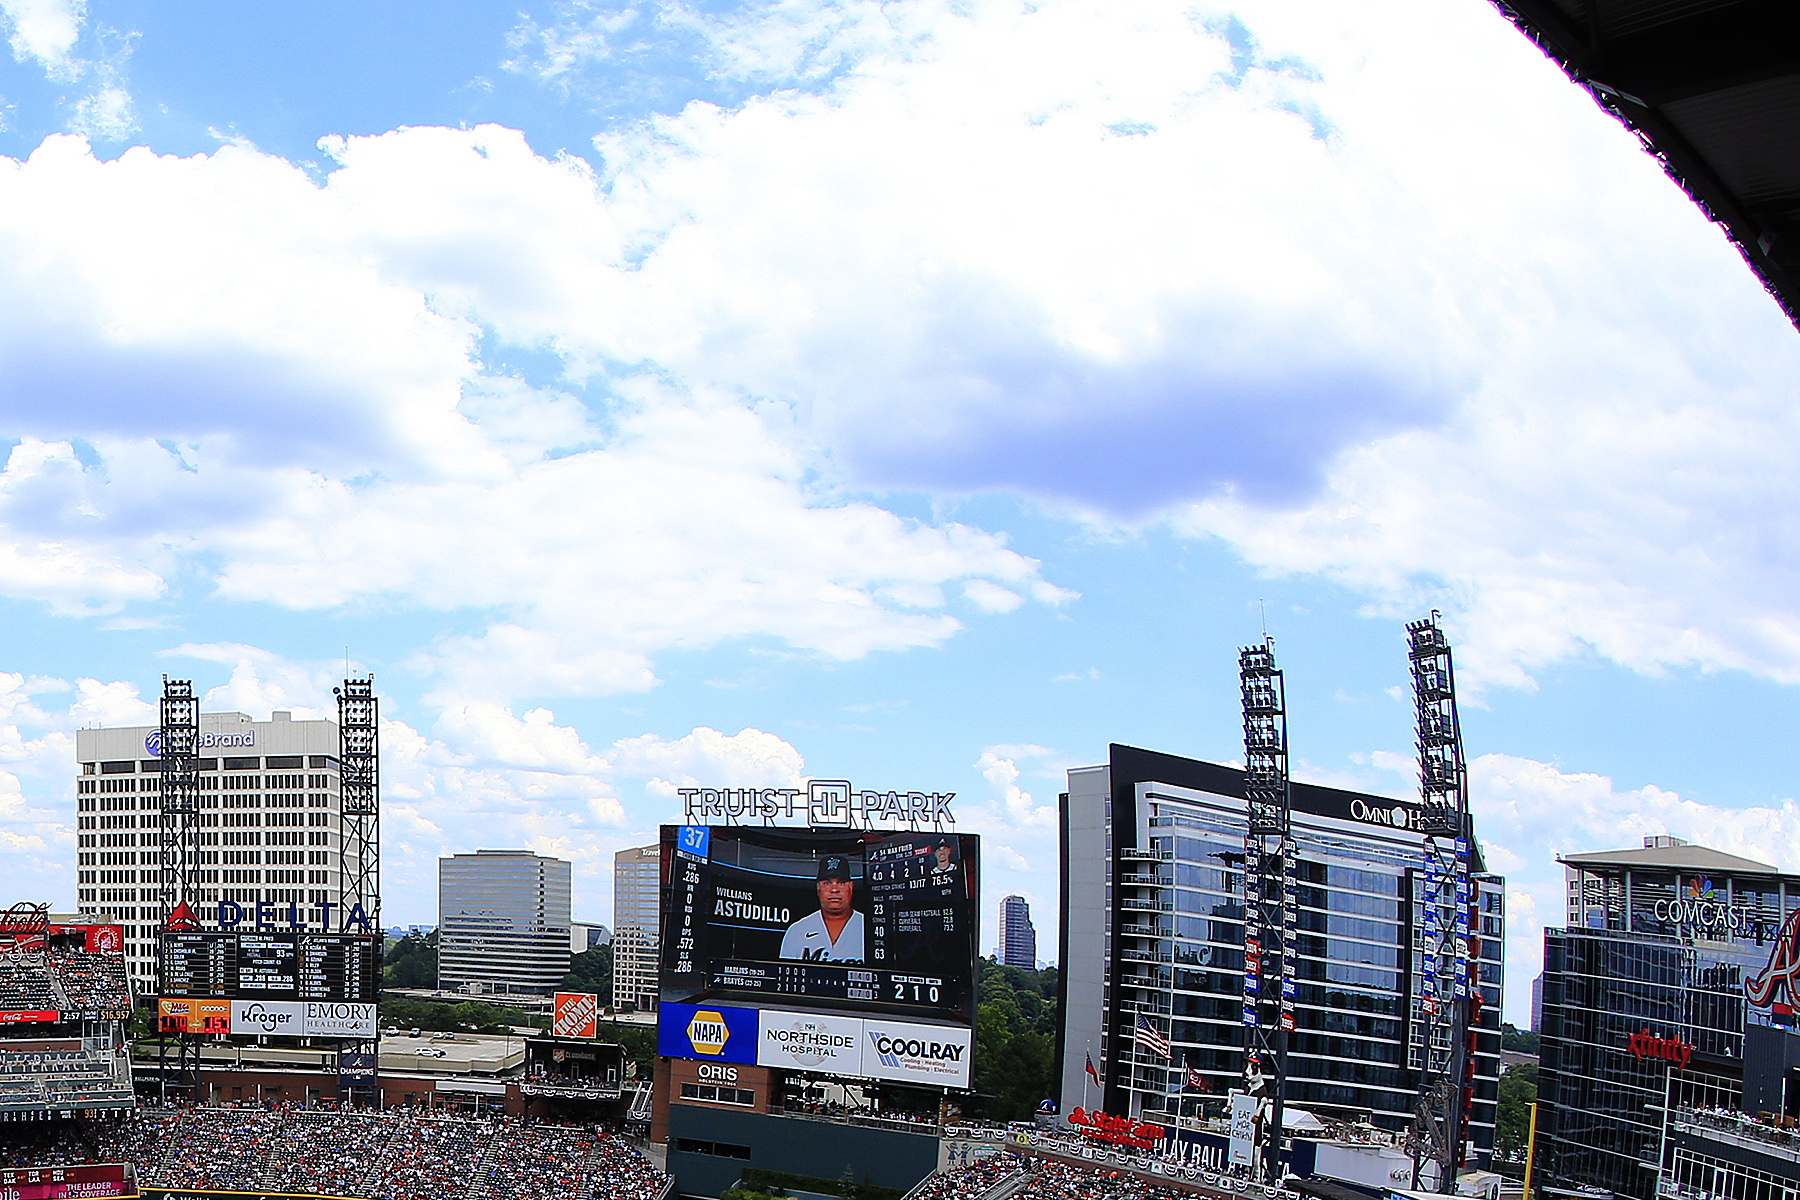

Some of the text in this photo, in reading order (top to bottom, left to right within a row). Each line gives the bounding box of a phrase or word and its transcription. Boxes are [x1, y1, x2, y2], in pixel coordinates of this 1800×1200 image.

[678, 789, 956, 823] TRUIST PARK
[1351, 799, 1391, 825] OMNI
[685, 827, 705, 849] 37
[682, 871, 699, 884] .286
[873, 872, 883, 881] 4.0
[909, 879, 926, 889] 13/17
[716, 886, 753, 900] WILLIANS
[219, 901, 371, 929] DELTA
[714, 900, 790, 923] ASTUDILLO
[874, 904, 883, 915] 23
[1654, 899, 1749, 930] COMCAST
[874, 927, 884, 937] 40
[677, 938, 694, 949] .572
[875, 948, 884, 960] 63
[674, 961, 692, 973] .286
[724, 976, 744, 986] BRAVES
[894, 984, 904, 999] 2
[929, 987, 938, 1003] 0
[307, 1003, 373, 1020] EMORY
[558, 998, 576, 1015] THE
[64, 1012, 80, 1020] 2:57
[209, 1017, 230, 1028] 157
[241, 1003, 292, 1031] Kroger
[554, 995, 597, 1036] HOME
[307, 1020, 370, 1030] HEALTHCARE
[570, 1010, 596, 1038] DEPOT
[694, 1022, 723, 1044] NAPA
[767, 1029, 854, 1048] NORTHSIDE
[782, 1044, 837, 1057] HOSPITAL
[877, 1036, 966, 1062] COOLRAY
[1627, 1028, 1696, 1070] xfinity
[14, 1052, 90, 1073] TERRACE
[340, 1067, 374, 1076] CHAMPIONS
[698, 1063, 738, 1081] ORIS
[84, 1109, 93, 1118] 93
[1238, 1109, 1251, 1119] EAT
[83, 1182, 112, 1191] LEADER
